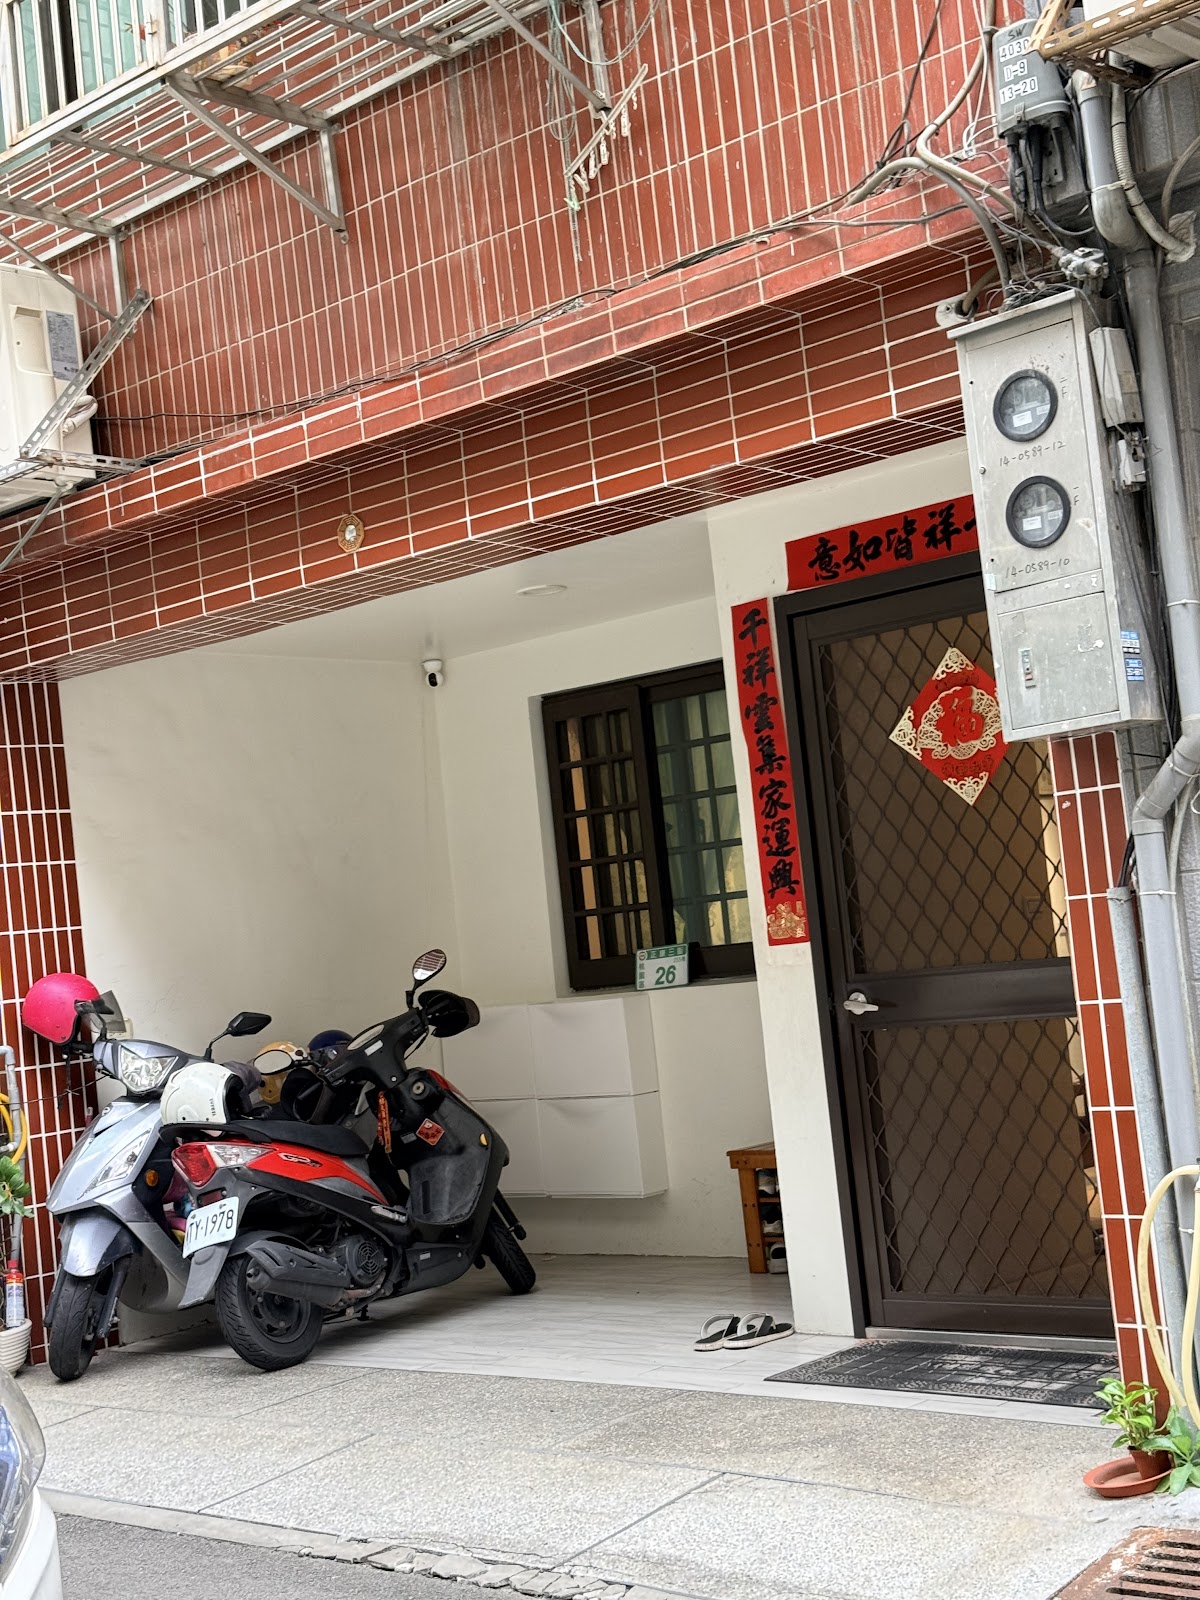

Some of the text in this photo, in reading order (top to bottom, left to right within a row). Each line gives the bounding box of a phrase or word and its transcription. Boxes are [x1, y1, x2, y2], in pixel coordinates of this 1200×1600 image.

[1005, 61, 1026, 80] D-9
[1001, 78, 1037, 102] 13-20
[999, 440, 1067, 467] 14-0589-12
[1005, 557, 1070, 579] 14-0589-10
[738, 607, 801, 899] 千祥雲集家運興
[655, 964, 677, 986] 26
